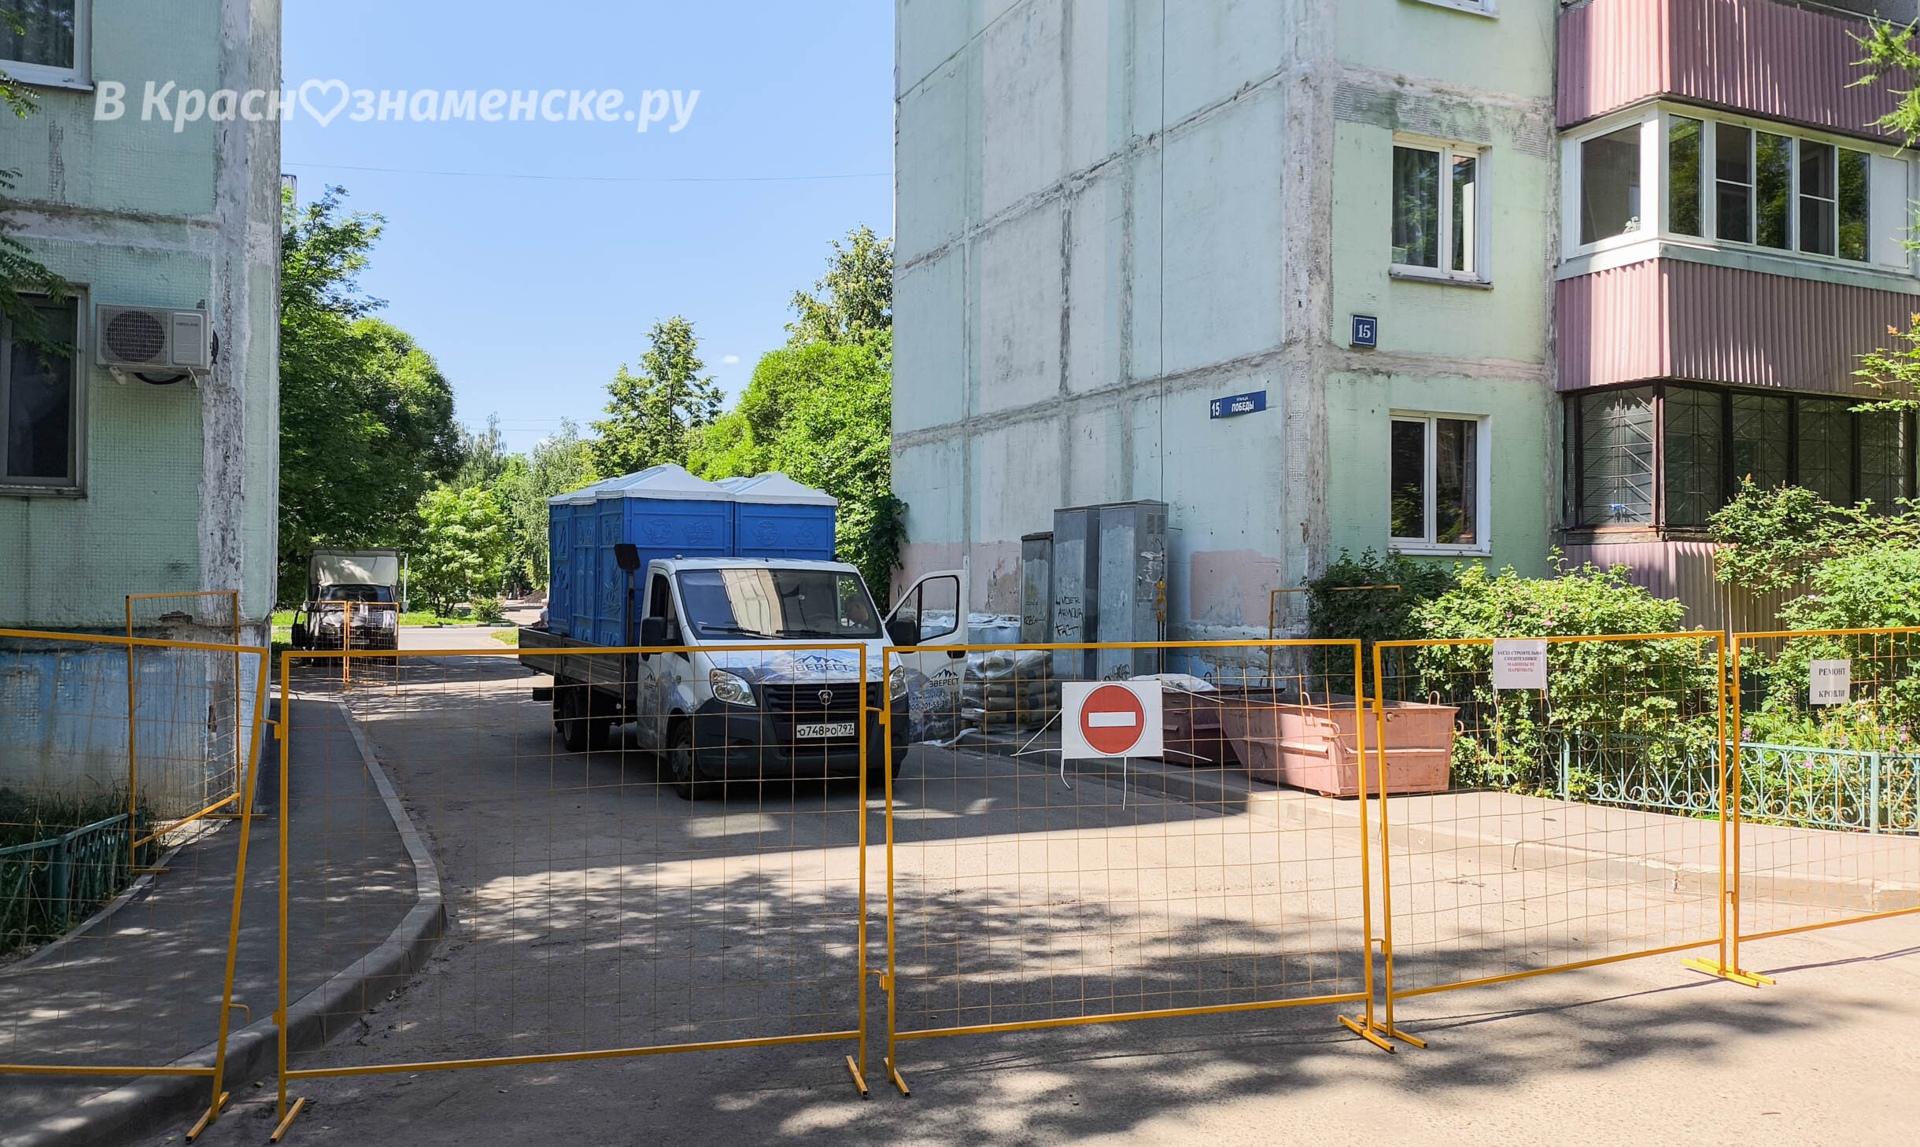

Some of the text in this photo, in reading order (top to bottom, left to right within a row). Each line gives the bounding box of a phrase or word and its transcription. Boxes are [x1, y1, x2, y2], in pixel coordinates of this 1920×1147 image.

[1358, 324, 1371, 338] 15
[1211, 400, 1255, 417] 15 ПОБЕДЫ
[1818, 668, 1846, 676] РЕМОНТ
[929, 678, 959, 688] ЭВЕРЕСТ
[1818, 690, 1845, 698] КРОВЛИ
[838, 724, 853, 732] 797
